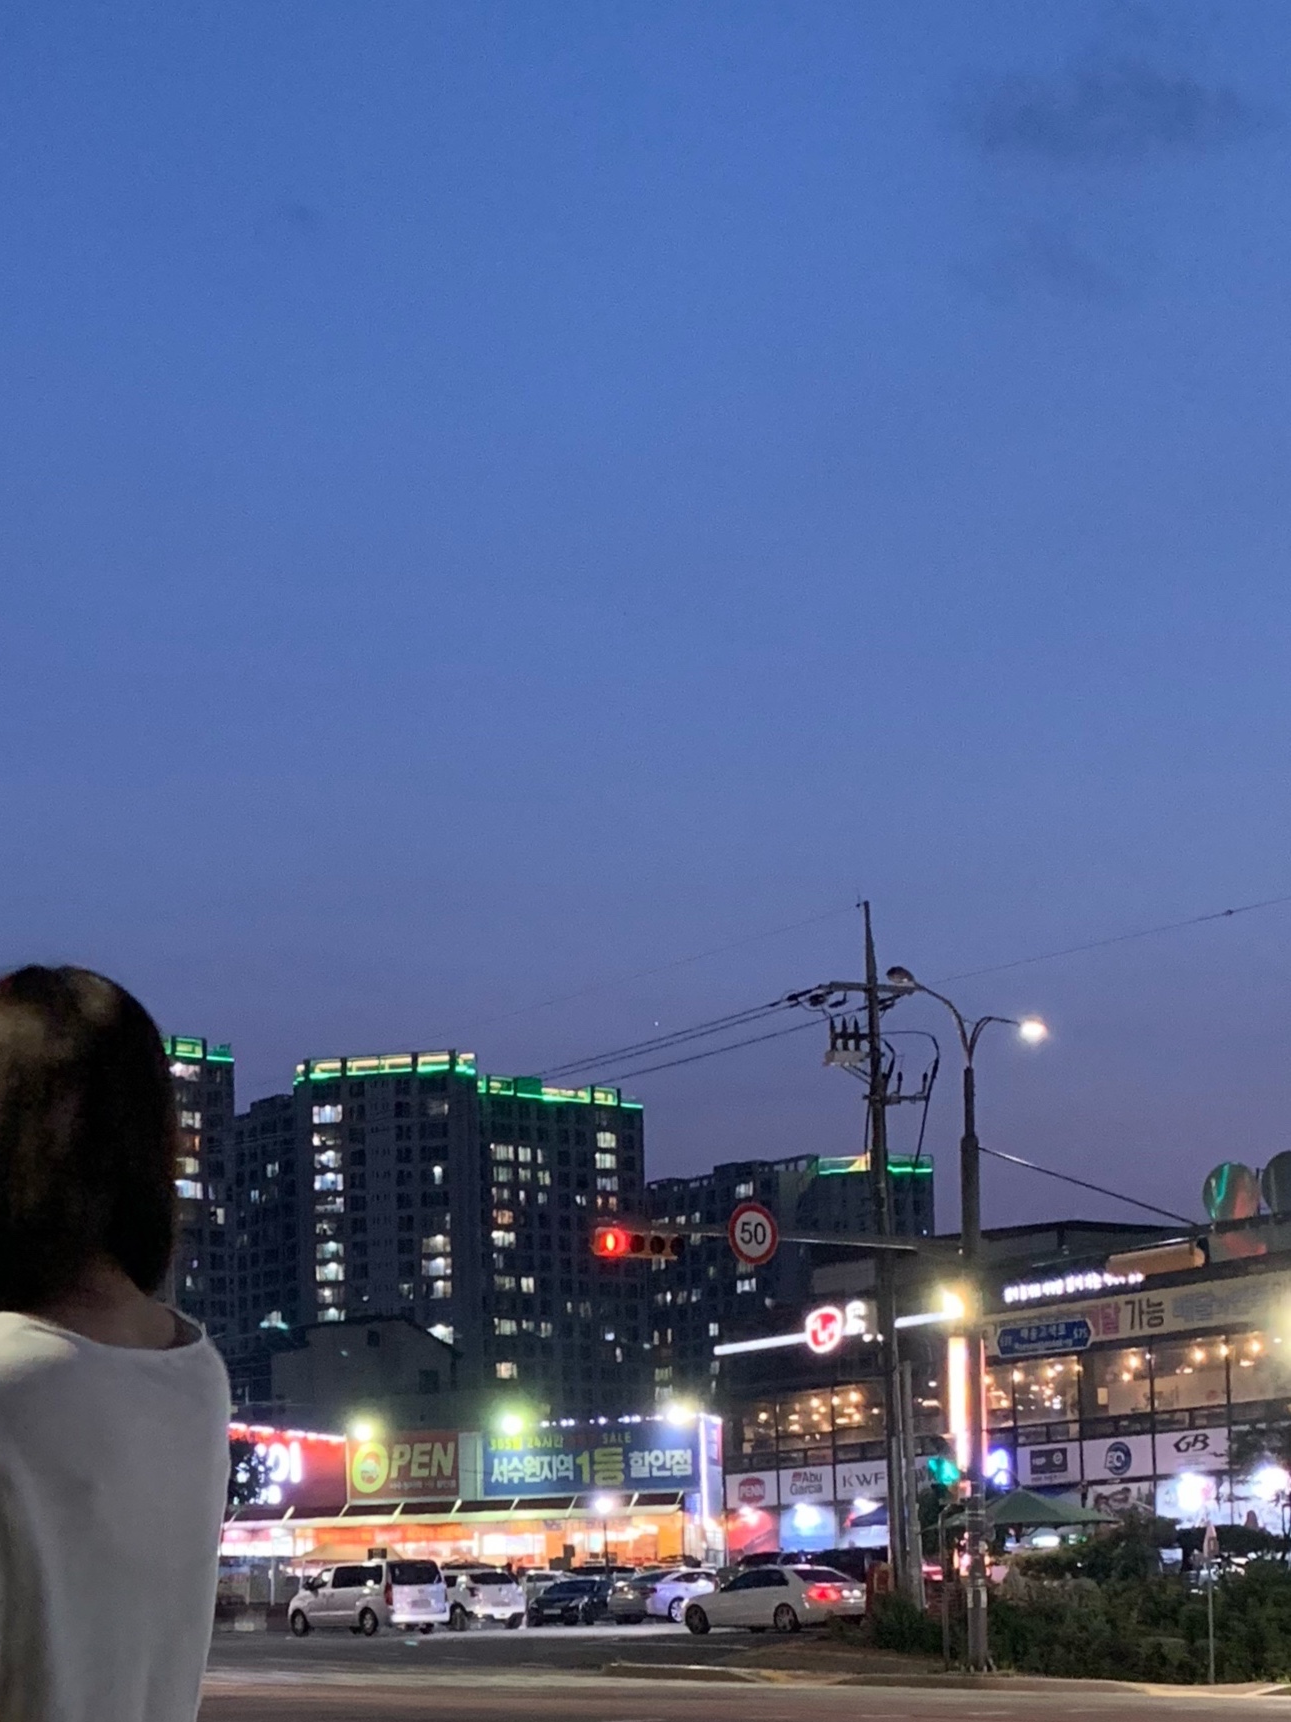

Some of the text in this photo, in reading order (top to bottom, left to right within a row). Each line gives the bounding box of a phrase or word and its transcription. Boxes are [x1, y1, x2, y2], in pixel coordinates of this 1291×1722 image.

[740, 1222, 766, 1245] 50
[1124, 1297, 1165, 1331] 가능
[602, 1431, 632, 1445] SALE
[351, 1442, 456, 1493] OPEN
[491, 1446, 693, 1486] 서수원지역 1등 할인점
[802, 1471, 823, 1483] Abu
[739, 1484, 766, 1497] PENN
[790, 1481, 823, 1495] Garcia
